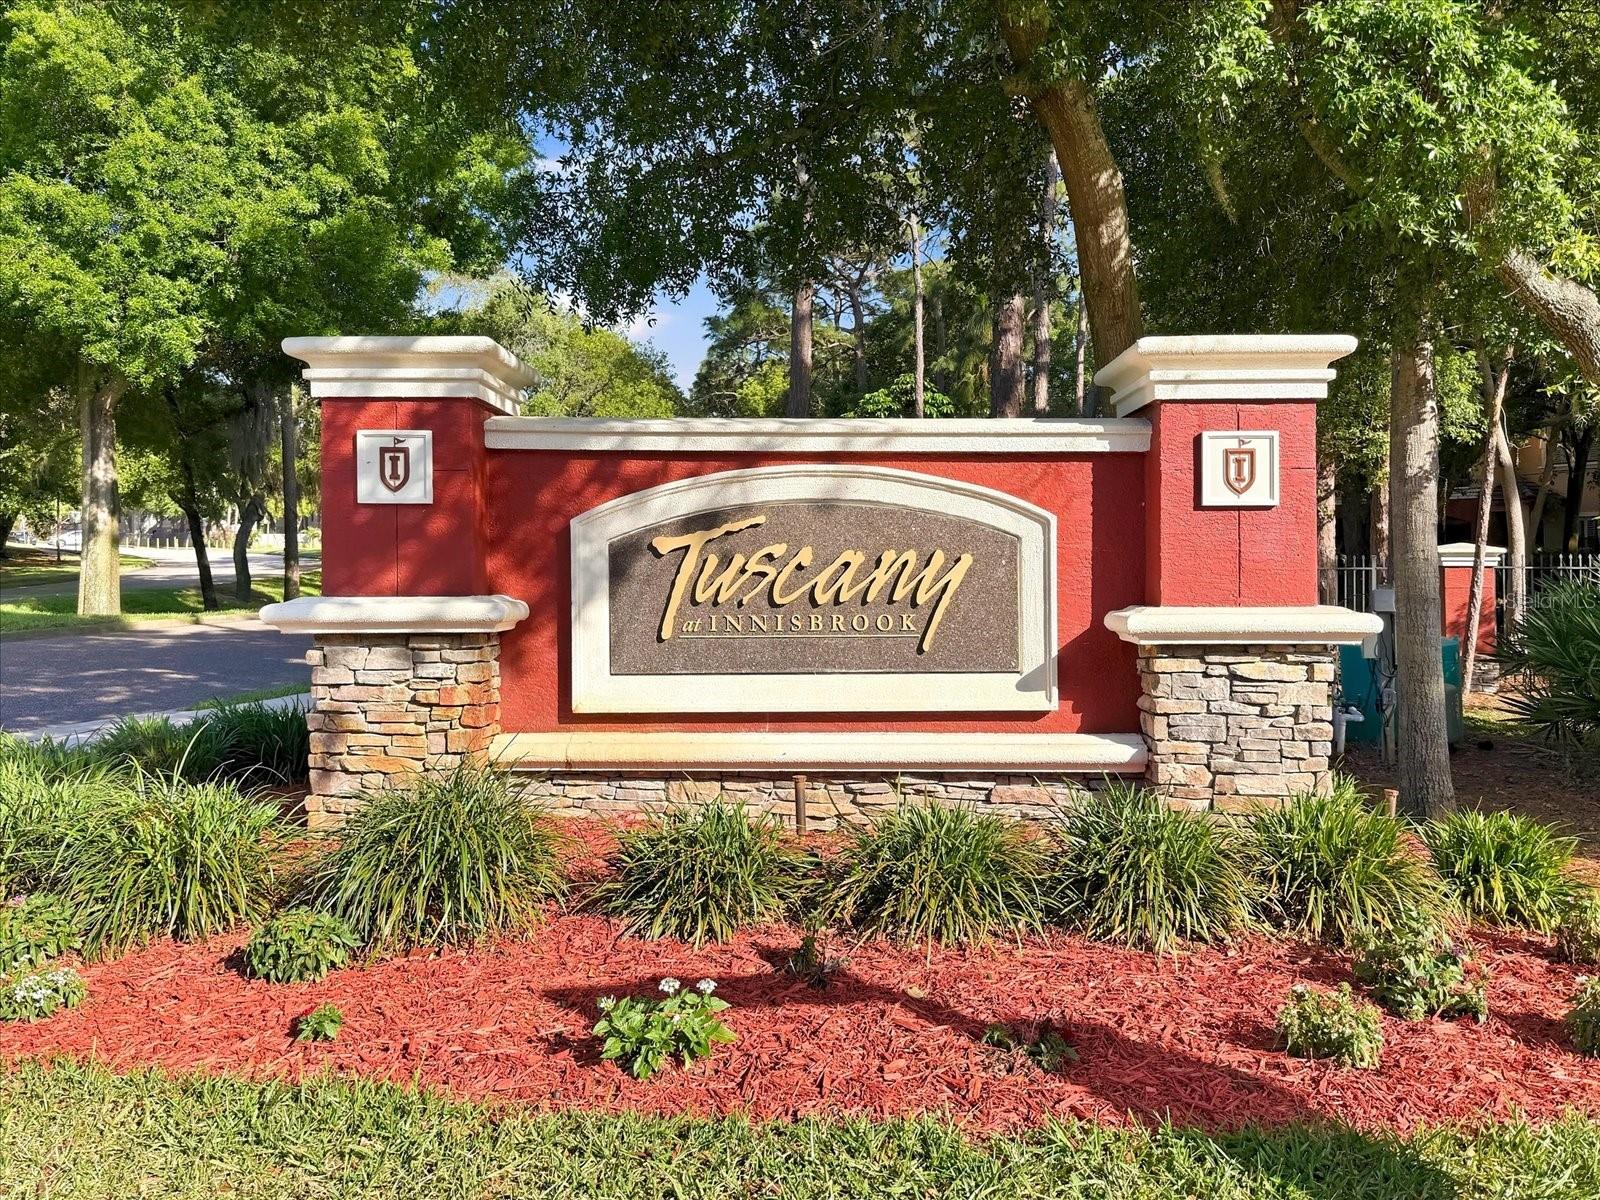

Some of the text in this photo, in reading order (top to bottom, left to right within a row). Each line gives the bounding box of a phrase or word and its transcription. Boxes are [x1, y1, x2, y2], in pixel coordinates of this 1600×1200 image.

[651, 515, 973, 652] Tuscany
[681, 614, 918, 633] at INNISBROOK
